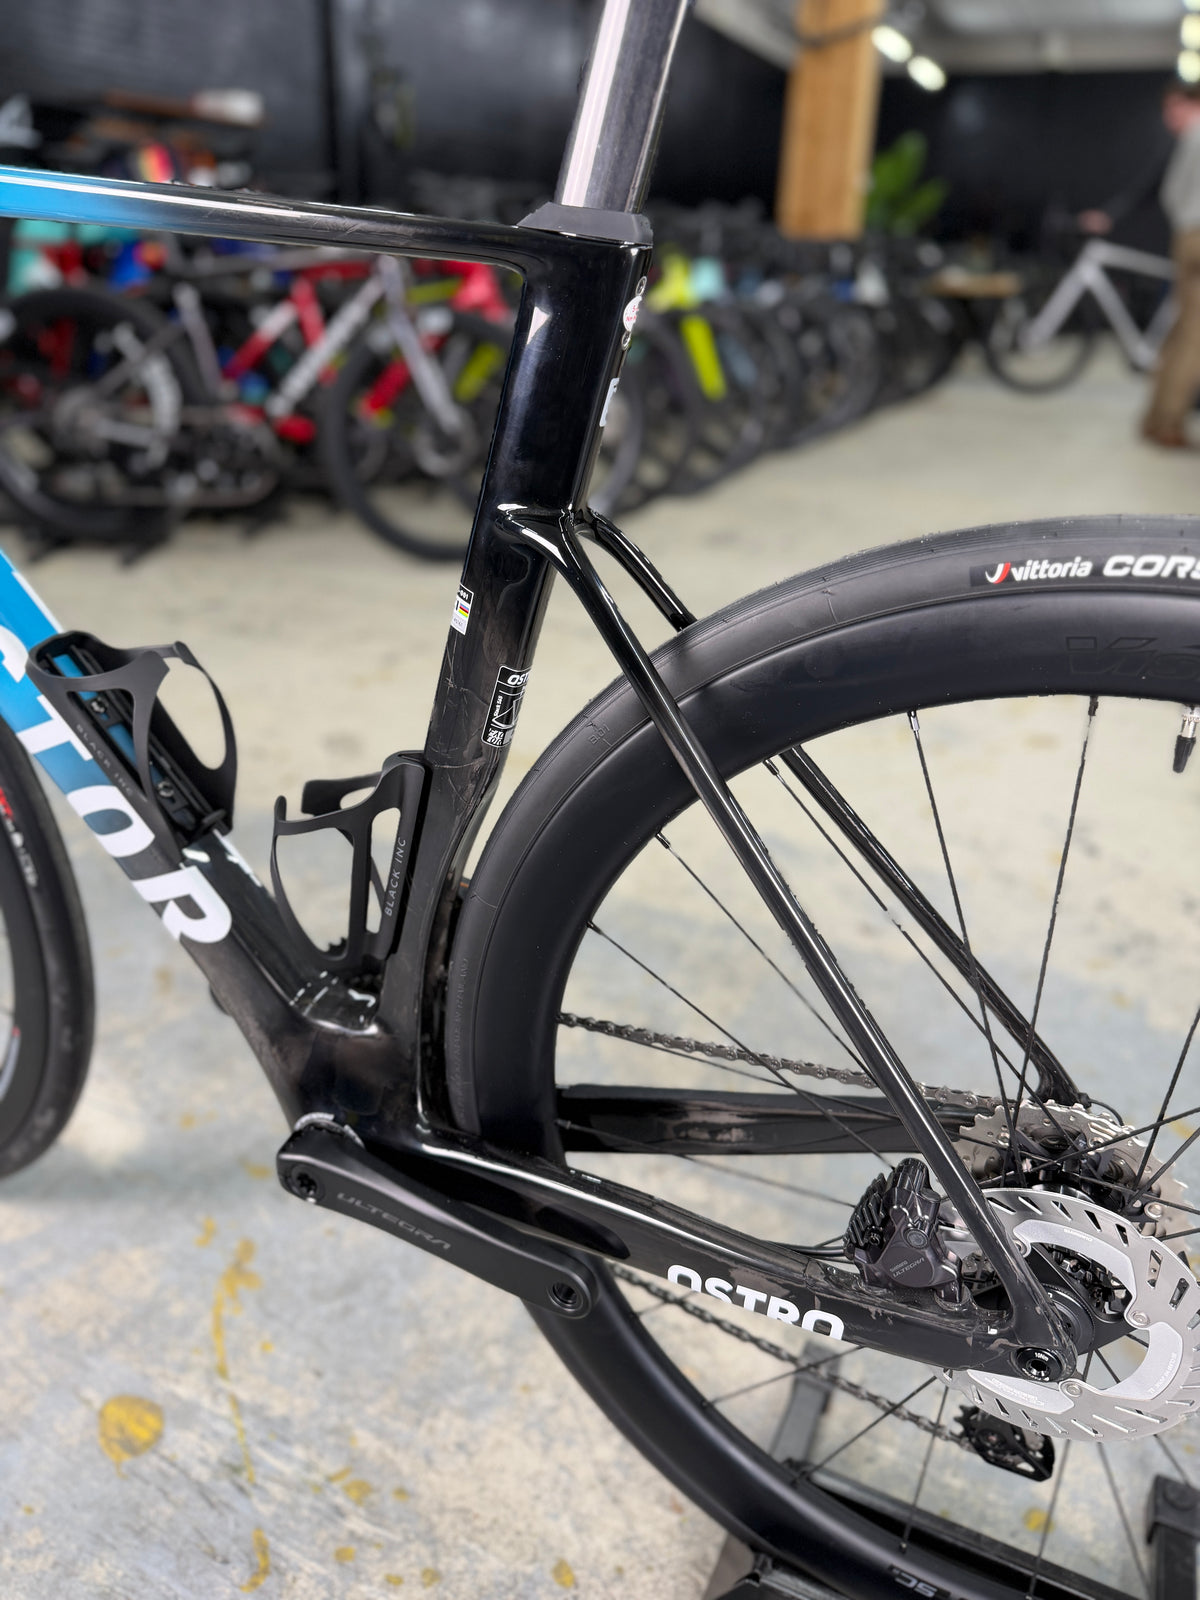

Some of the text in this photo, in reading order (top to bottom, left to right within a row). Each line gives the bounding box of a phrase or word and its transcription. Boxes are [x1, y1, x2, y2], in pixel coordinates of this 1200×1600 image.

[1010, 556, 1093, 581] vittoria
[76, 723, 134, 797] BLACK INC
[384, 836, 406, 917] BLACK INC
[337, 1192, 451, 1250] ULTEGRA
[892, 1257, 925, 1278] ULTEGRA
[667, 1264, 845, 1341] OSTRO
